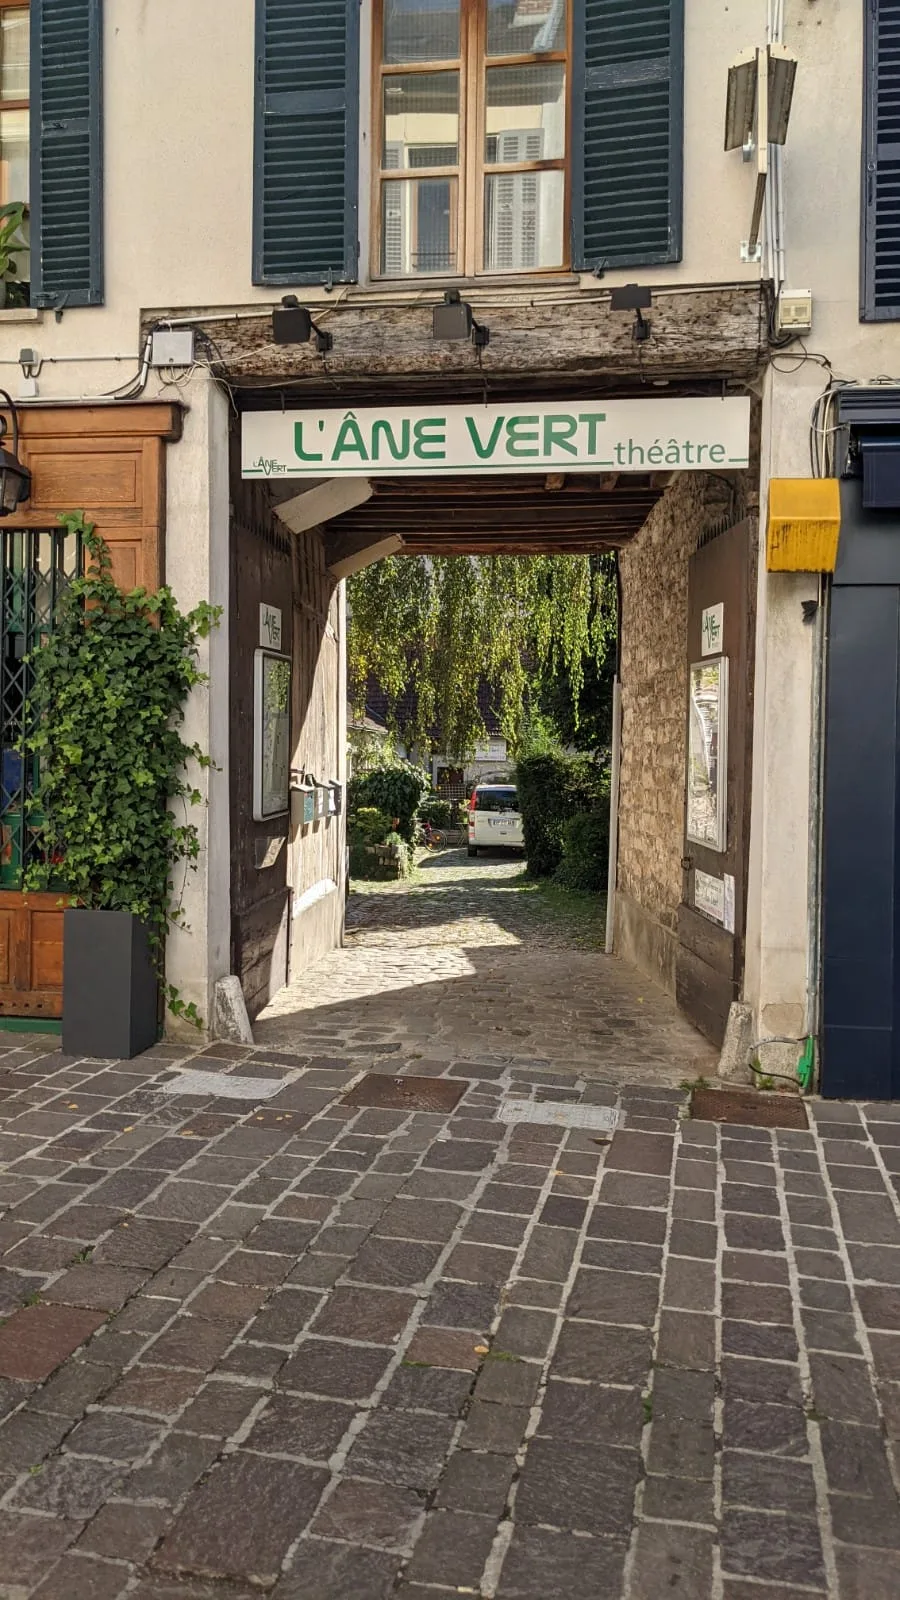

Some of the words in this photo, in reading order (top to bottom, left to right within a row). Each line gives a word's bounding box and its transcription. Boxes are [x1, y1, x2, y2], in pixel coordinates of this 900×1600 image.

[295, 411, 447, 462] L'ÂNE
[465, 413, 607, 460] VERT
[613, 438, 726, 465] théâtre
